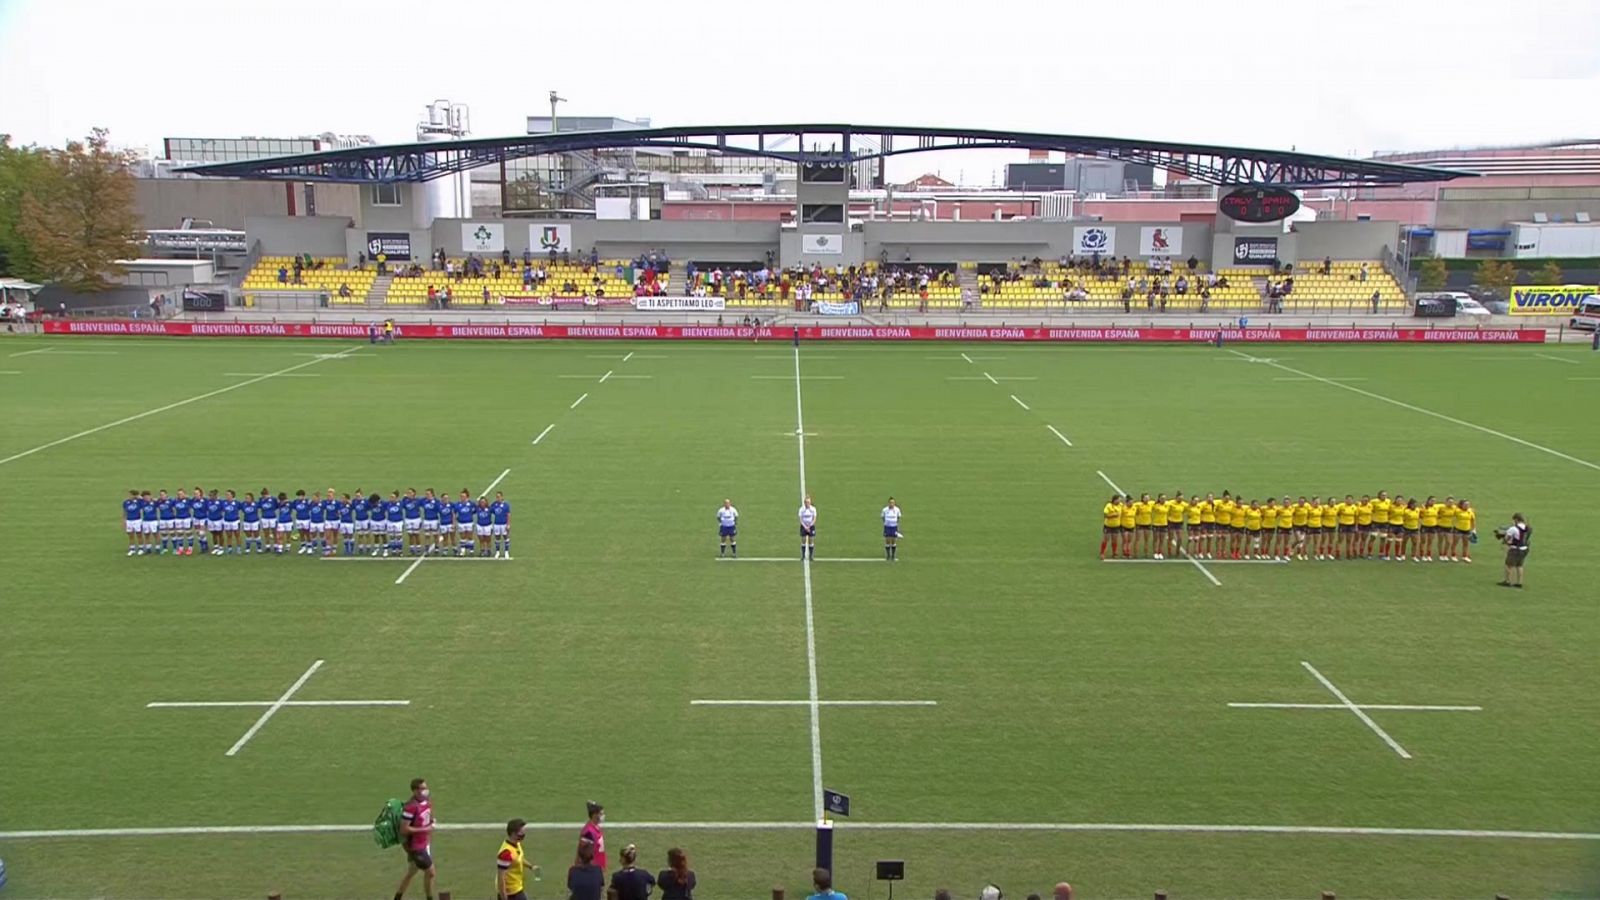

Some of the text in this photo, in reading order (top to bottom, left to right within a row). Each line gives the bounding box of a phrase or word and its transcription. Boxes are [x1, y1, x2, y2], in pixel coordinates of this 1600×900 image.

[70, 322, 166, 332] BIENVENIDA ESPAÑA
[192, 323, 285, 334] BIENVENIDA ESPAÑA
[310, 325, 364, 334] BIENVENIDA
[452, 325, 543, 336] BIENVENIDA ESPAÑA
[567, 326, 657, 336] BIENVENIDA ESPAÑA
[682, 327, 735, 336] BIENVENIDA
[821, 327, 910, 337] BIENVENIDA ESPAÑA
[935, 327, 1024, 337] BIENVENIDA ESPAÑA
[1050, 328, 1139, 338] BIENVENIDA ESPAÑA
[1245, 329, 1280, 339] ESPAÑA
[1306, 329, 1398, 339] BIENVENIDA ESPAÑA
[1424, 330, 1518, 340] BIENVENIDA ESPAÑA
